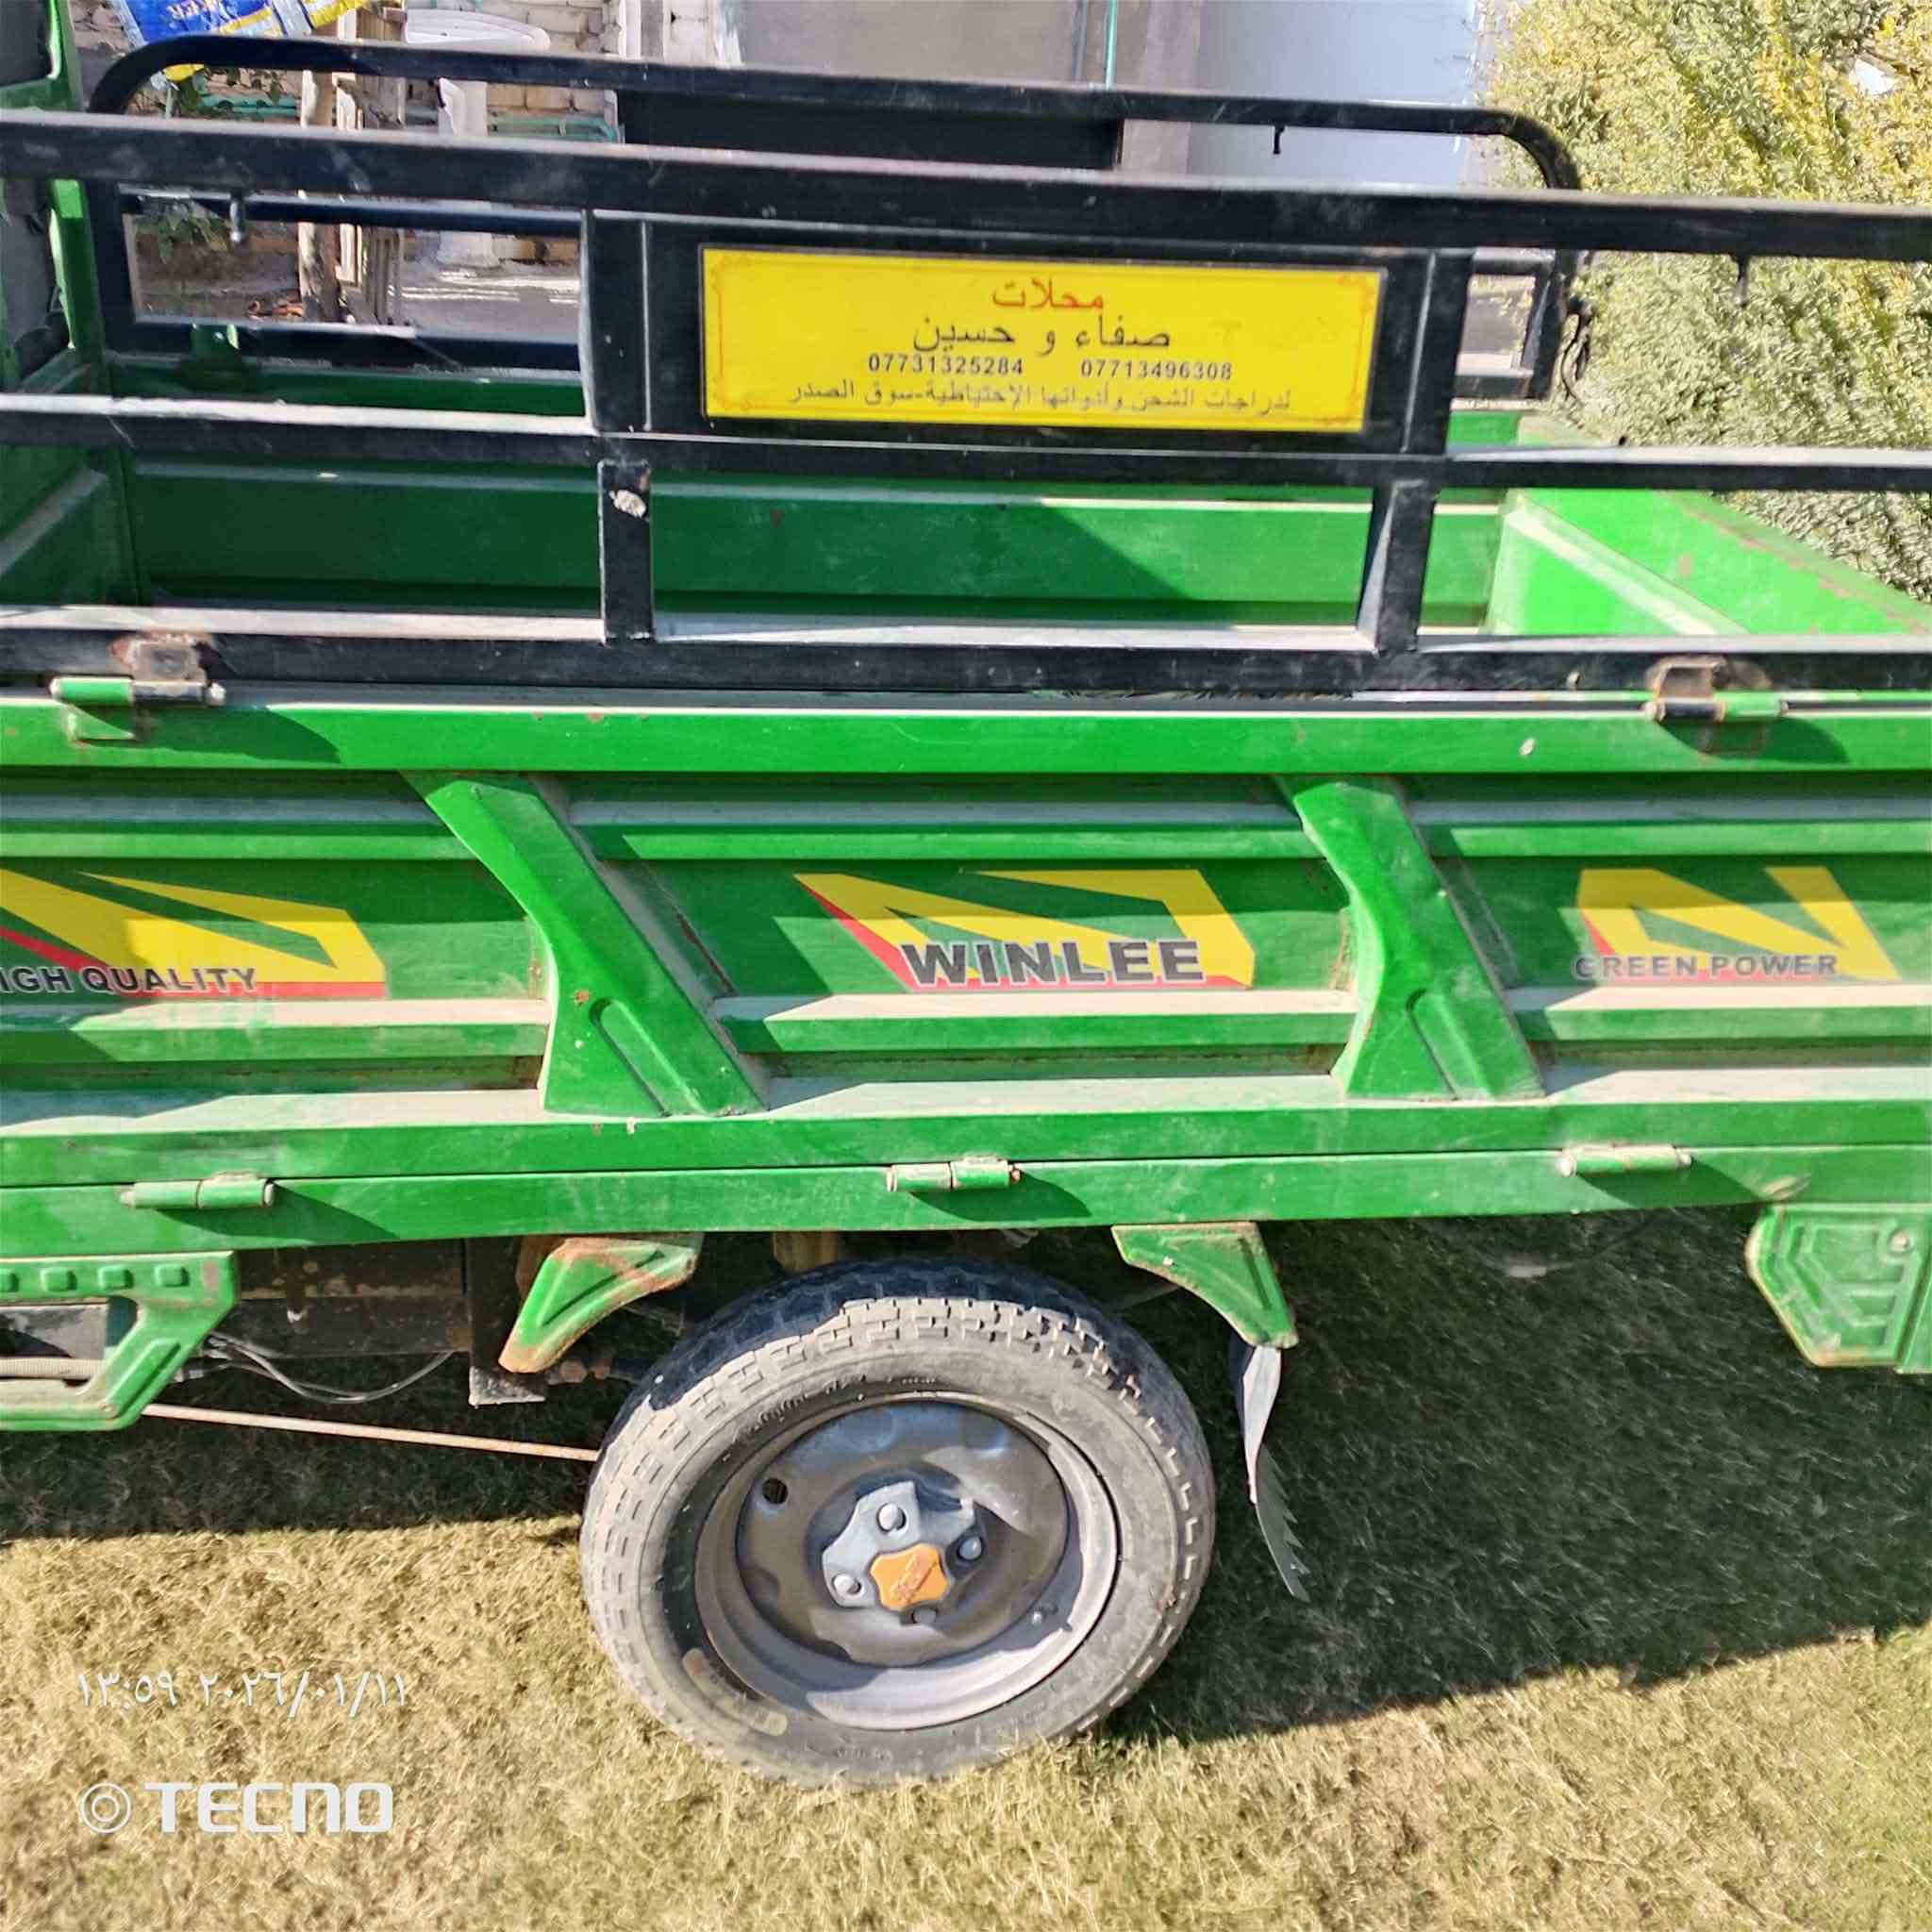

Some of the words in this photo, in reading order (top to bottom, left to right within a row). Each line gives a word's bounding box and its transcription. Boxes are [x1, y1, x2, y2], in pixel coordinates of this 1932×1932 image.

[991, 276, 1105, 310] محلات
[912, 316, 1016, 352] حسين
[1036, 329, 1056, 357] و
[1074, 314, 1171, 348] صفاء
[868, 353, 1024, 375] 07731325284
[1080, 358, 1233, 381] 07713496308
[899, 938, 1207, 988] WINLEE
[1573, 954, 1698, 979] GREEN
[1710, 953, 1839, 977] POWER
[81, 967, 258, 993] QUALITY
